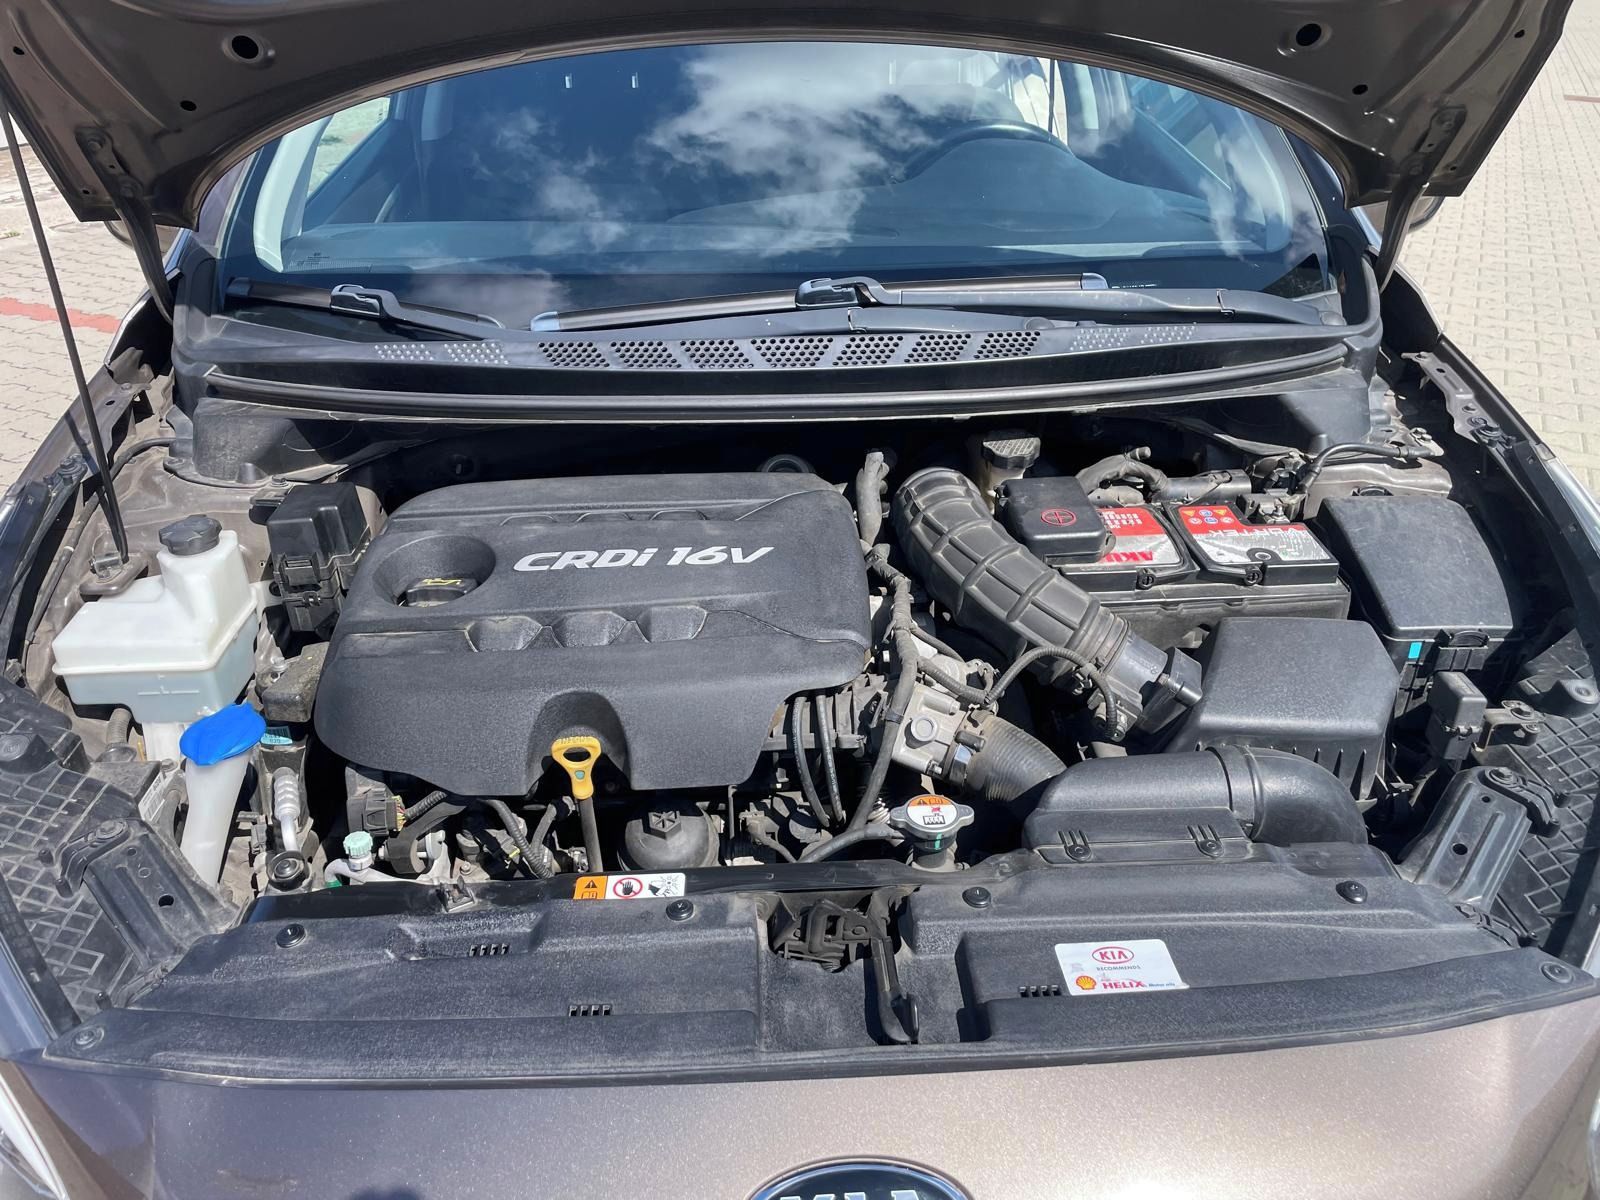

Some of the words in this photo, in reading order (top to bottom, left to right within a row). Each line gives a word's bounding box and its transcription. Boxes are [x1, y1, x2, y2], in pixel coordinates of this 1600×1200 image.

[512, 547, 658, 572] CRDi
[666, 546, 775, 567] 16V
[1099, 950, 1128, 960] KIA
[1102, 981, 1145, 989] HELIX
